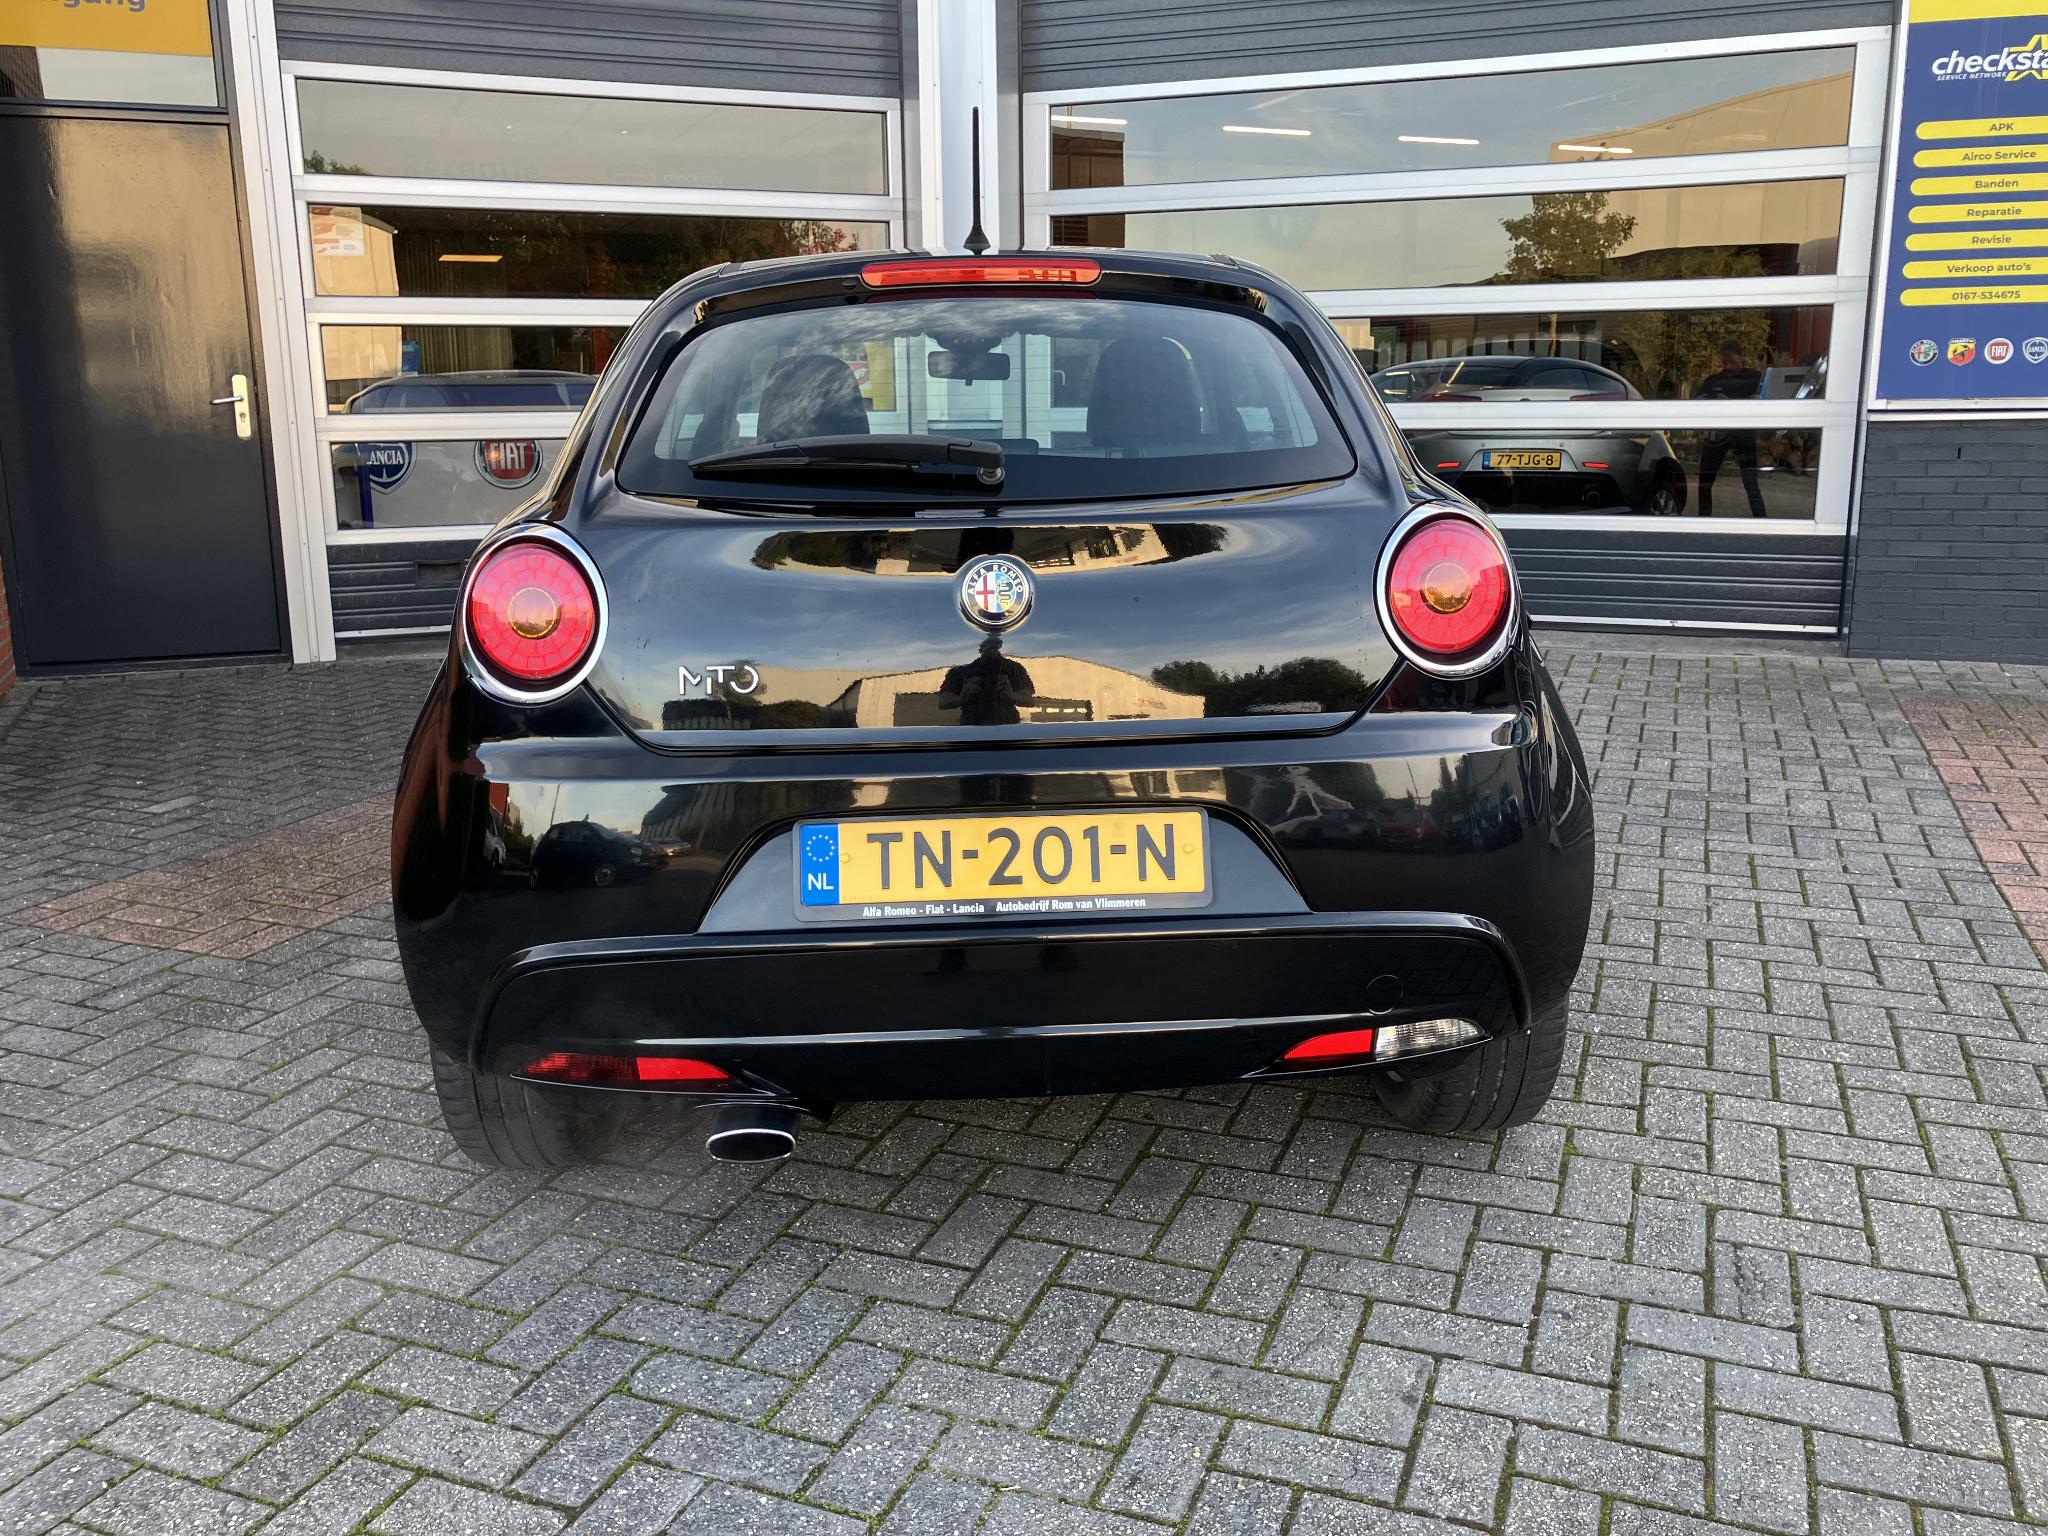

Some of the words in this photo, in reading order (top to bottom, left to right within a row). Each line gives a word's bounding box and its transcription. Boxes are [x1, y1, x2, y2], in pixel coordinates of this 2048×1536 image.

[1937, 73, 1967, 81] SERVICE
[1969, 71, 2007, 79] NETWORK
[1989, 122, 2014, 132] APK
[1962, 152, 1992, 161] Airco
[1994, 150, 2037, 160] Service
[1975, 179, 2019, 189] Banden
[1967, 207, 2022, 218] Reparatie
[1972, 235, 2012, 245] Revisie
[1947, 264, 1994, 274] Verkoop
[1997, 262, 2032, 272] auto's
[1952, 290, 2021, 301] 0167-534675
[1991, 345, 2008, 357] FIAT
[366, 448, 404, 465] ANCIA
[488, 442, 528, 470] FIAT
[1497, 454, 1554, 466] 77-TJG-8
[967, 567, 988, 595] ALFA
[992, 564, 1023, 593] ROMEO
[866, 823, 1176, 889] TN-201-N
[807, 873, 834, 891] NL
[862, 906, 882, 917] Alfa
[884, 905, 917, 916] Romeo
[952, 902, 985, 914] Lancia
[995, 899, 1050, 912] Autobedrijf
[1051, 899, 1074, 910] Rom
[1075, 899, 1093, 909] van
[1094, 897, 1147, 909] Vlimmeren
